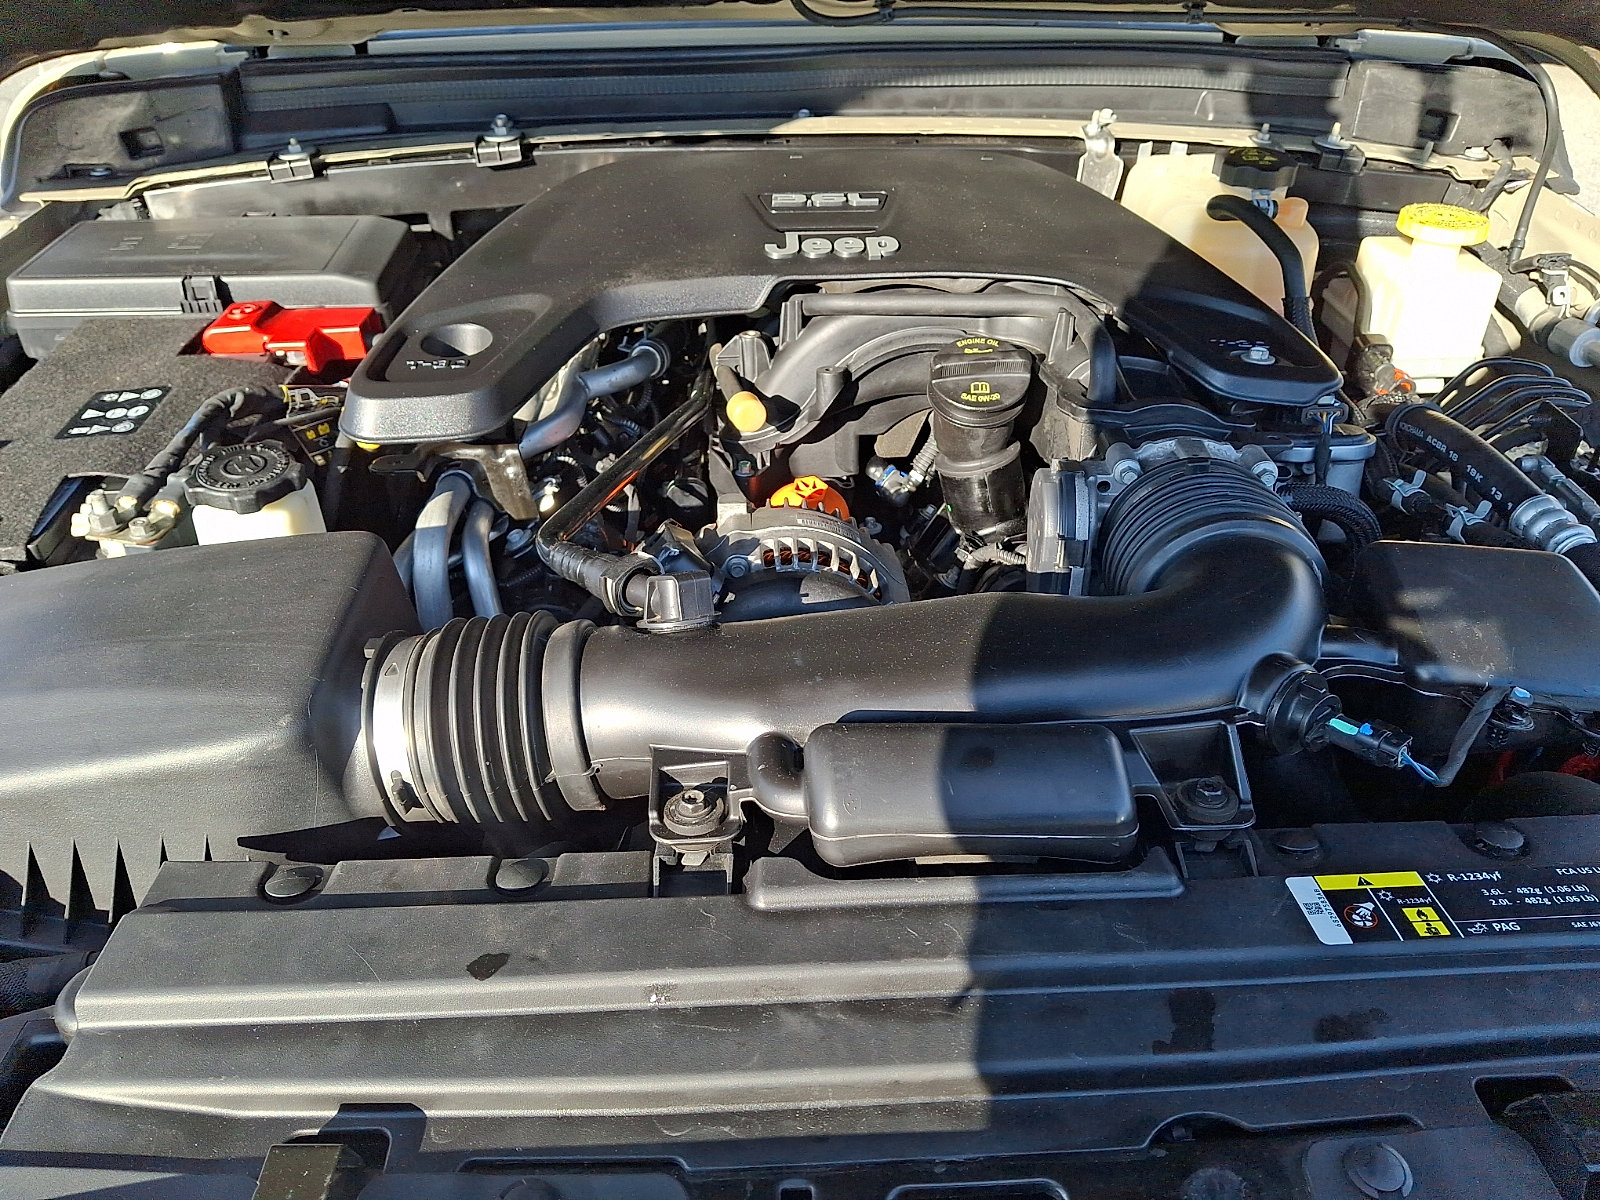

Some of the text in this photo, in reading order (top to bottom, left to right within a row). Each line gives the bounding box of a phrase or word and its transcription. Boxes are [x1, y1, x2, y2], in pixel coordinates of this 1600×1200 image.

[765, 231, 900, 260] Jeep
[956, 338, 999, 347] ENGINE OIL
[961, 393, 977, 401] SAE
[1555, 867, 1578, 875] FCA
[1446, 871, 1502, 882] R-1234yf
[1489, 898, 1513, 906] 2.0L
[1492, 922, 1521, 932] PAG
